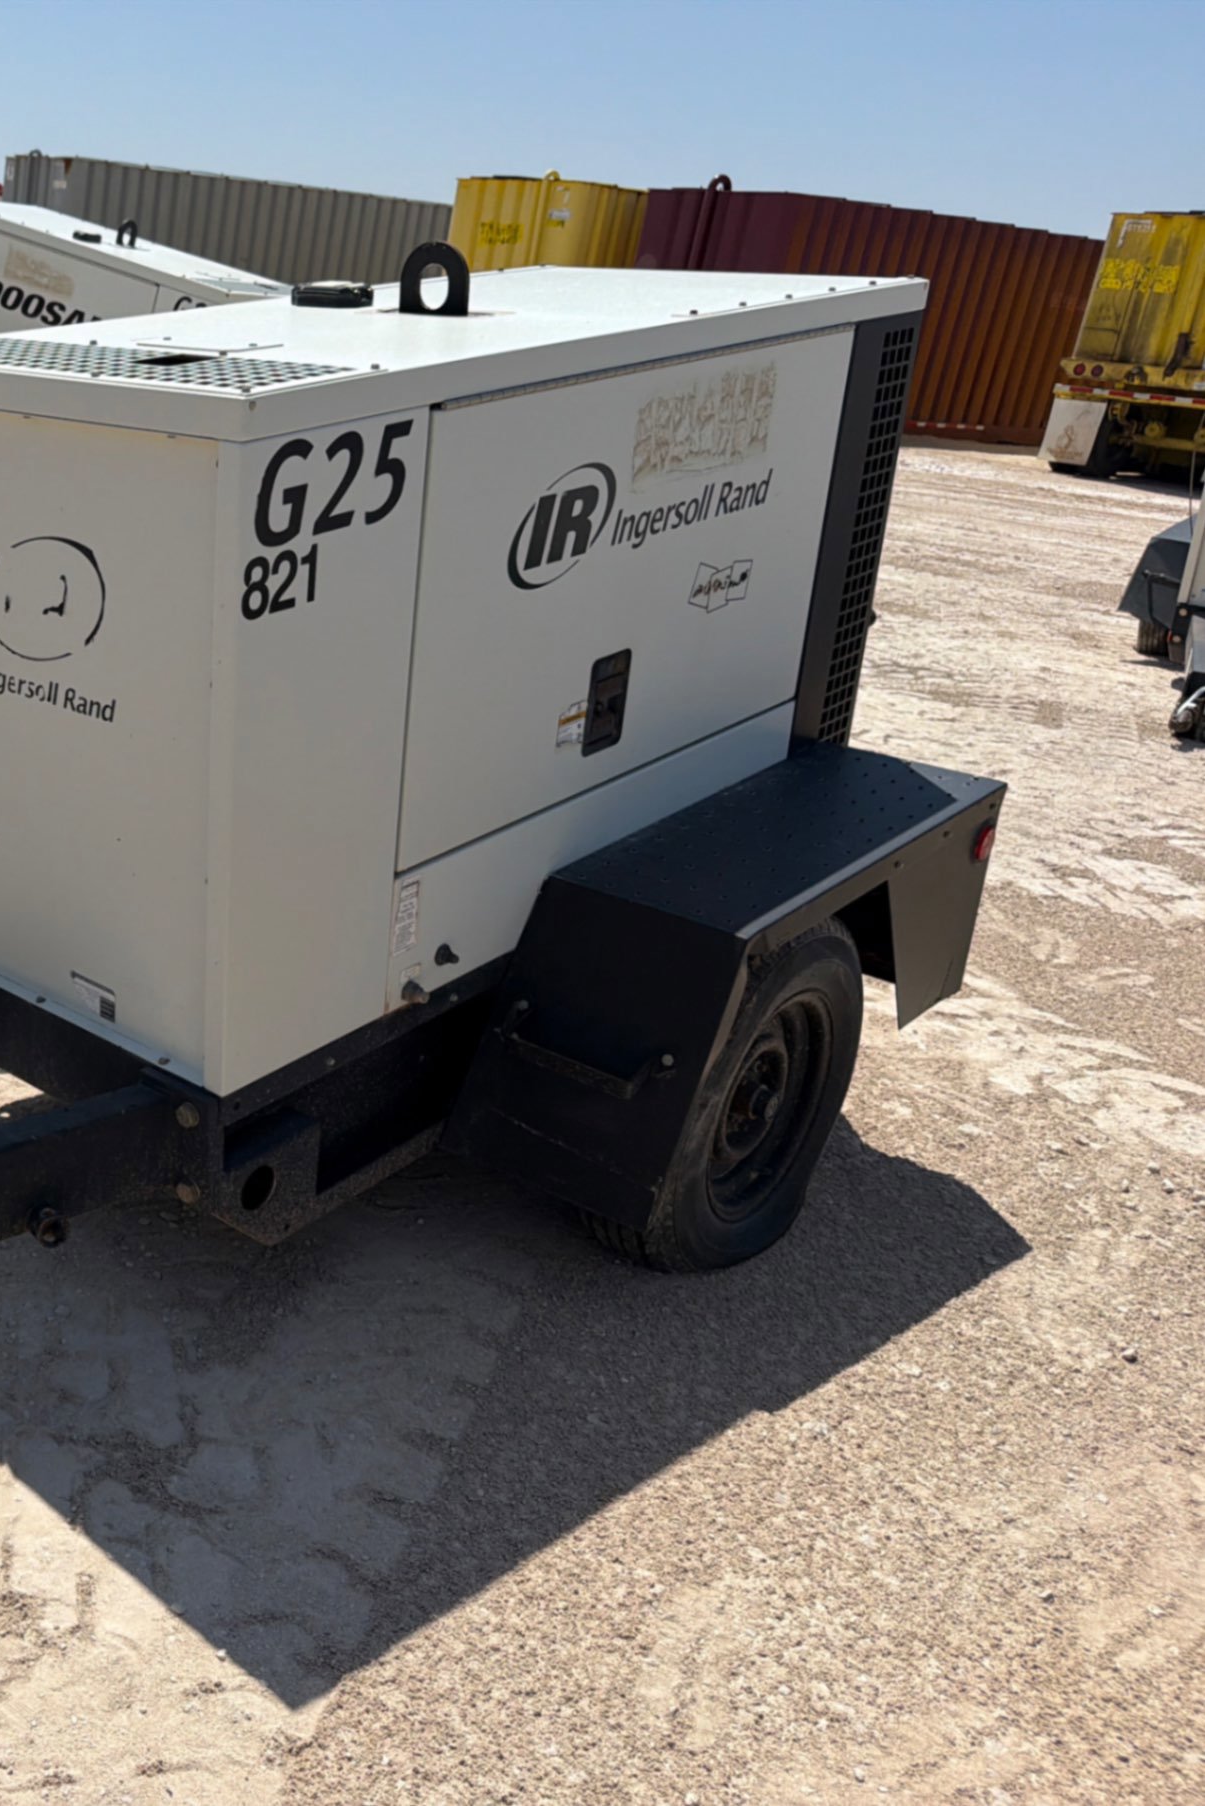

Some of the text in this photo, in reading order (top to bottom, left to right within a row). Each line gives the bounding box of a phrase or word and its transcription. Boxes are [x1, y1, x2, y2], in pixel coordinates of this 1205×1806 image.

[254, 418, 414, 548] G25
[610, 468, 773, 550] Ingersoll Rand
[523, 484, 600, 571] IR
[241, 543, 318, 621] 821
[63, 687, 117, 723] Rand
